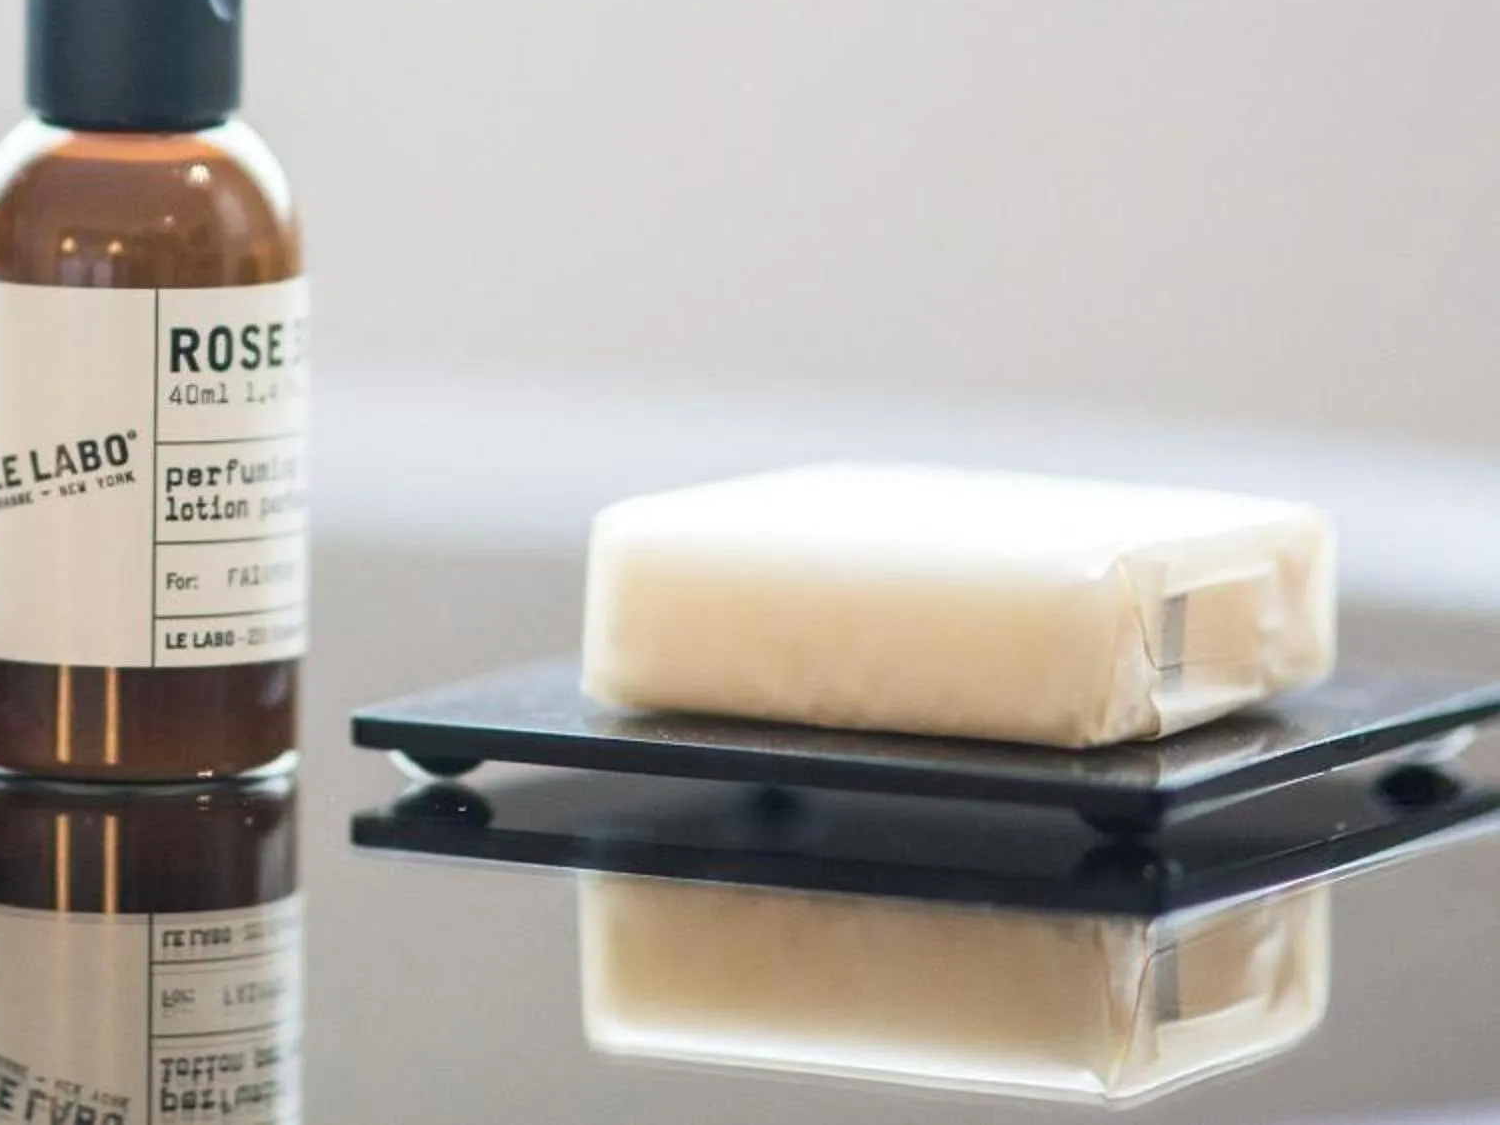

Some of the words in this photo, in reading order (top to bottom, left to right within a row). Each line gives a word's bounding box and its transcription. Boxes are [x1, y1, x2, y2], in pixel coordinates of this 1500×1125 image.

[170, 322, 283, 373] ROSE
[169, 383, 228, 405] 40ml
[165, 494, 249, 521] lotion
[165, 632, 187, 649] LE
[193, 629, 235, 649] LABO
